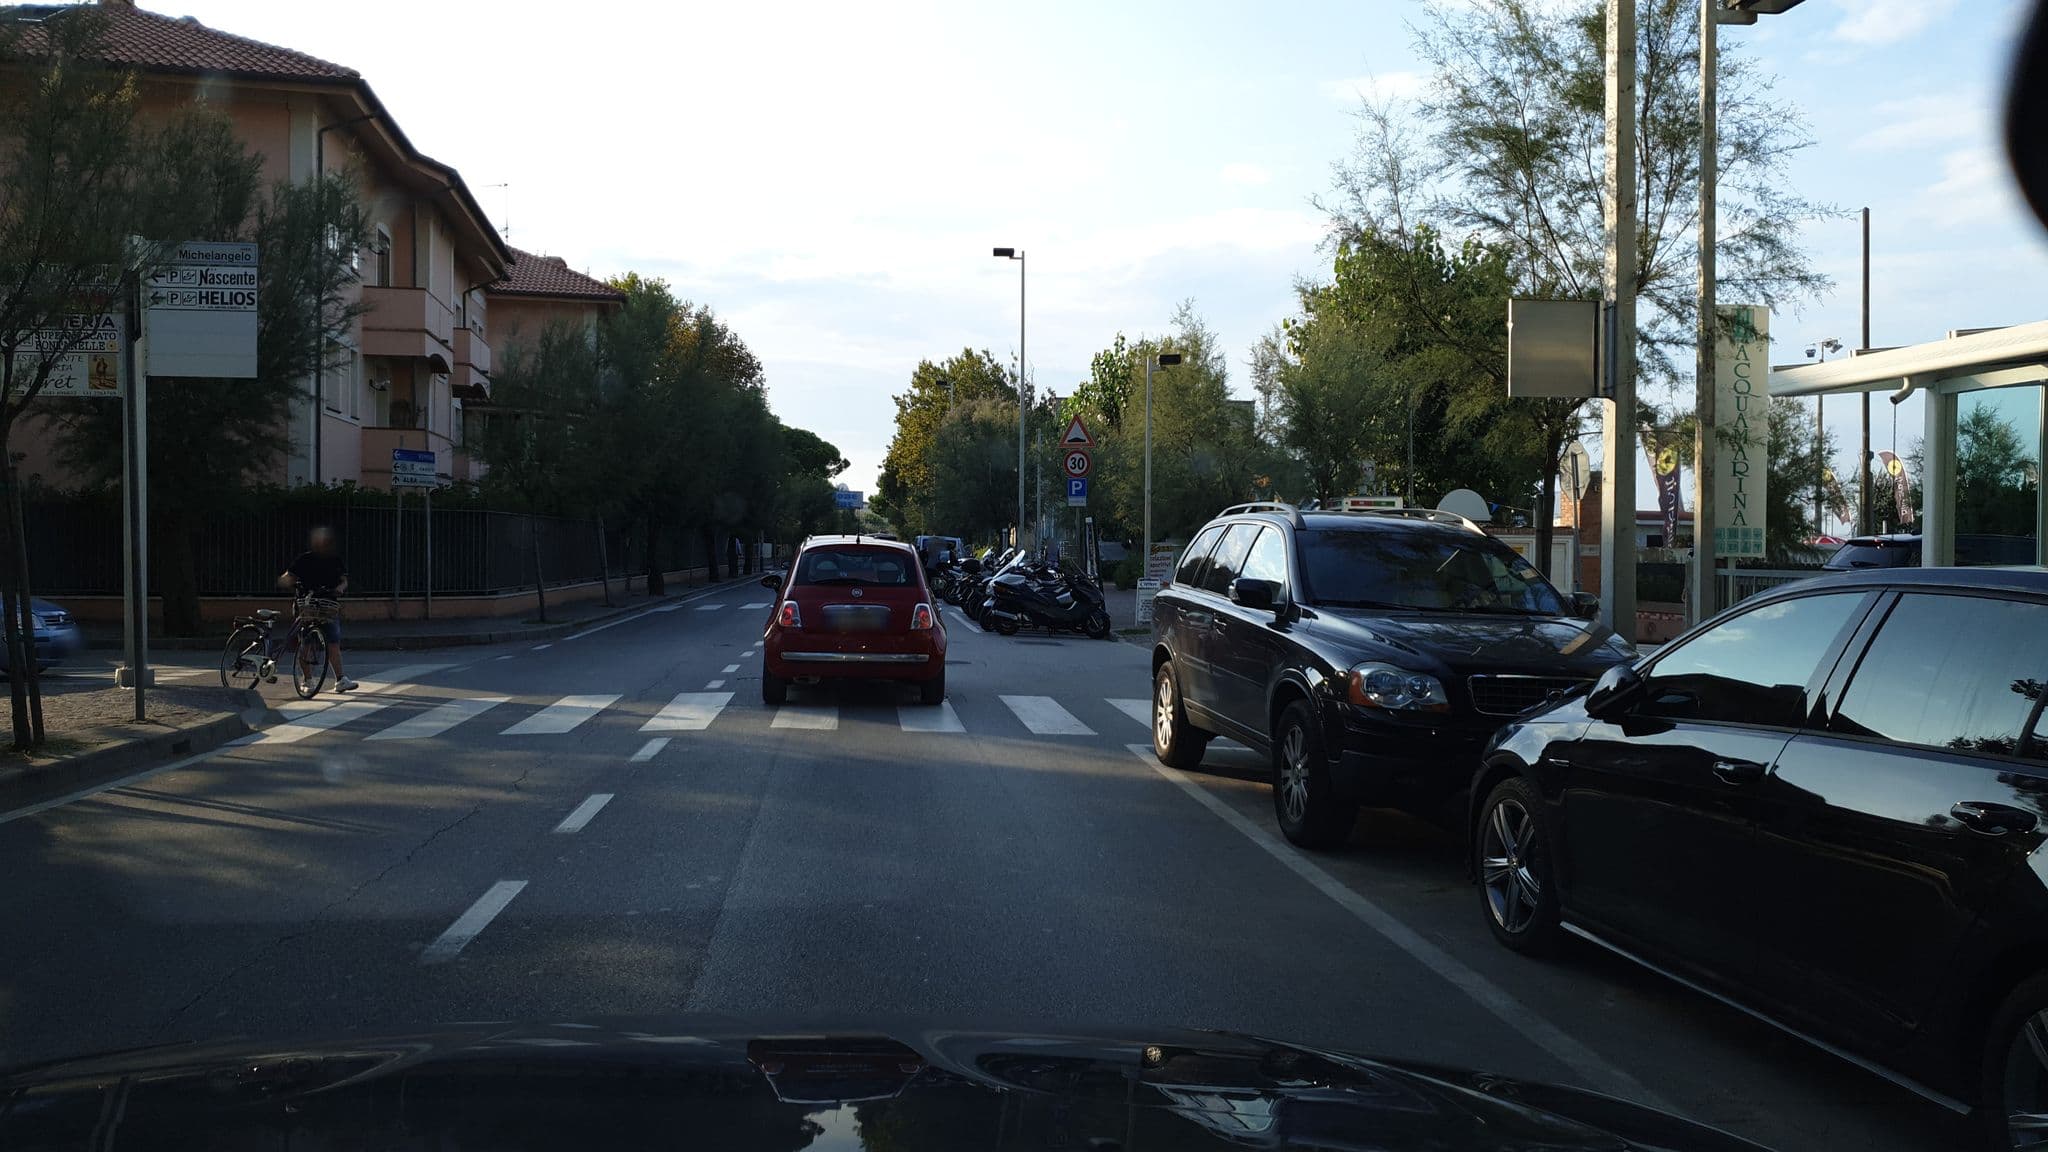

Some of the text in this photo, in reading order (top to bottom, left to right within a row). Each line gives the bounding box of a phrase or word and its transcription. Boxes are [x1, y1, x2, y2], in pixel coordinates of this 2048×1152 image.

[179, 249, 252, 263] Michelangelo
[198, 268, 255, 286] Nascente
[199, 291, 256, 306] HELIOS
[1732, 344, 1761, 527] ACQUAMARINA
[1070, 457, 1085, 471] 30
[1071, 480, 1083, 495] P
